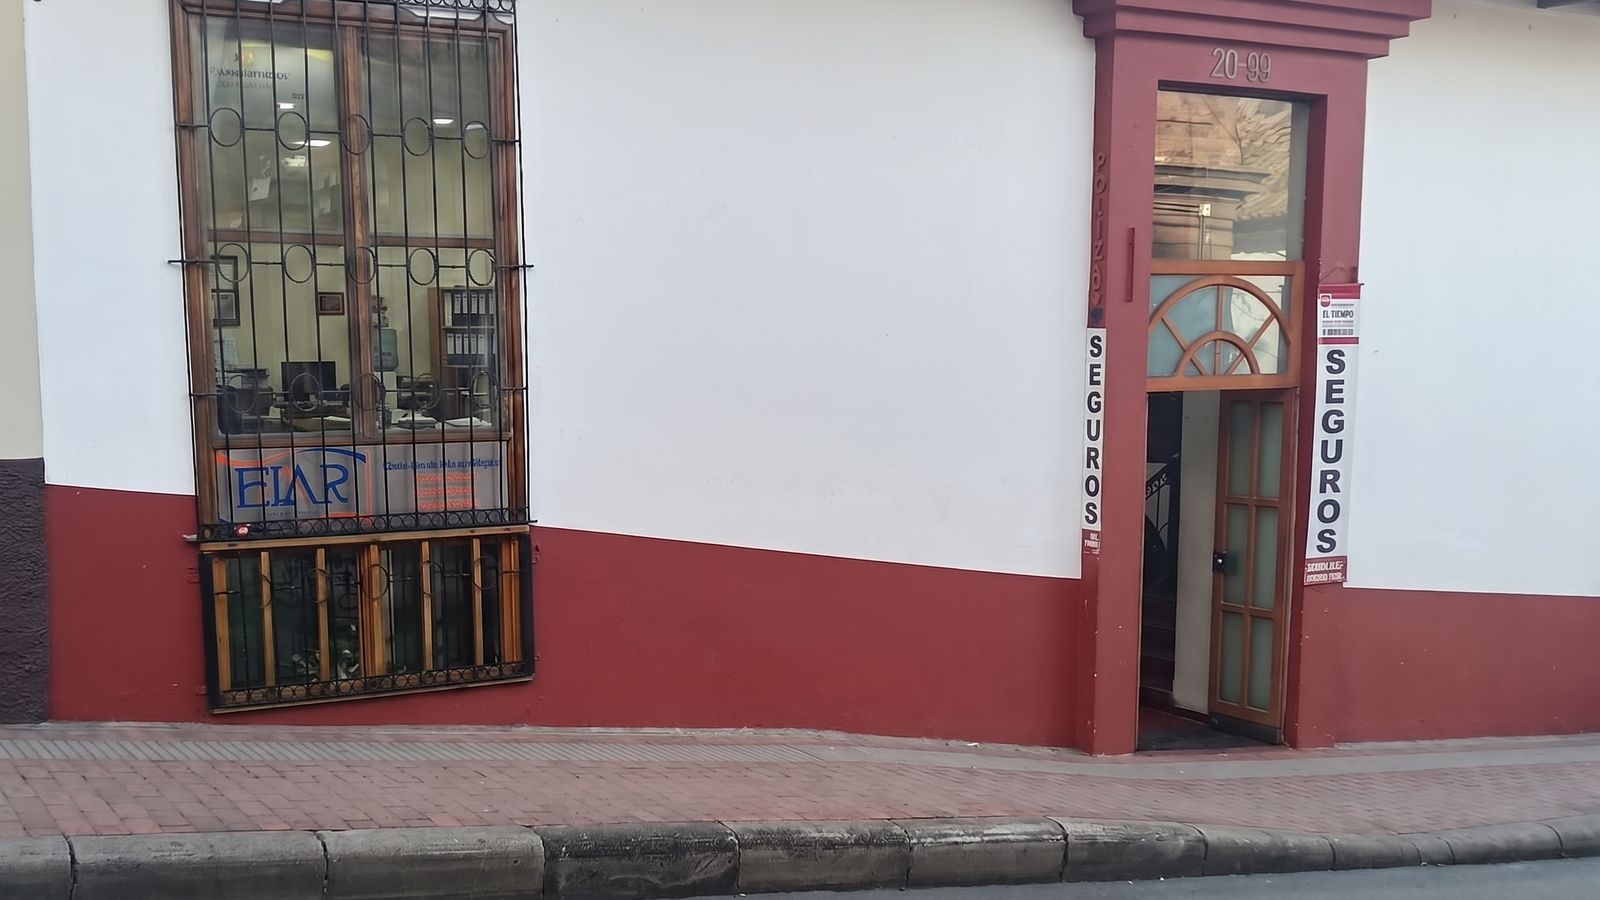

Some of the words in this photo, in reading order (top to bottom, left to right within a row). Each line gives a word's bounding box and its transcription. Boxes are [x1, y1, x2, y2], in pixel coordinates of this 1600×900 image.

[1210, 47, 1271, 82] 20-99
[1085, 335, 1102, 524] SEGUROS
[1316, 349, 1346, 554] SEGUROS
